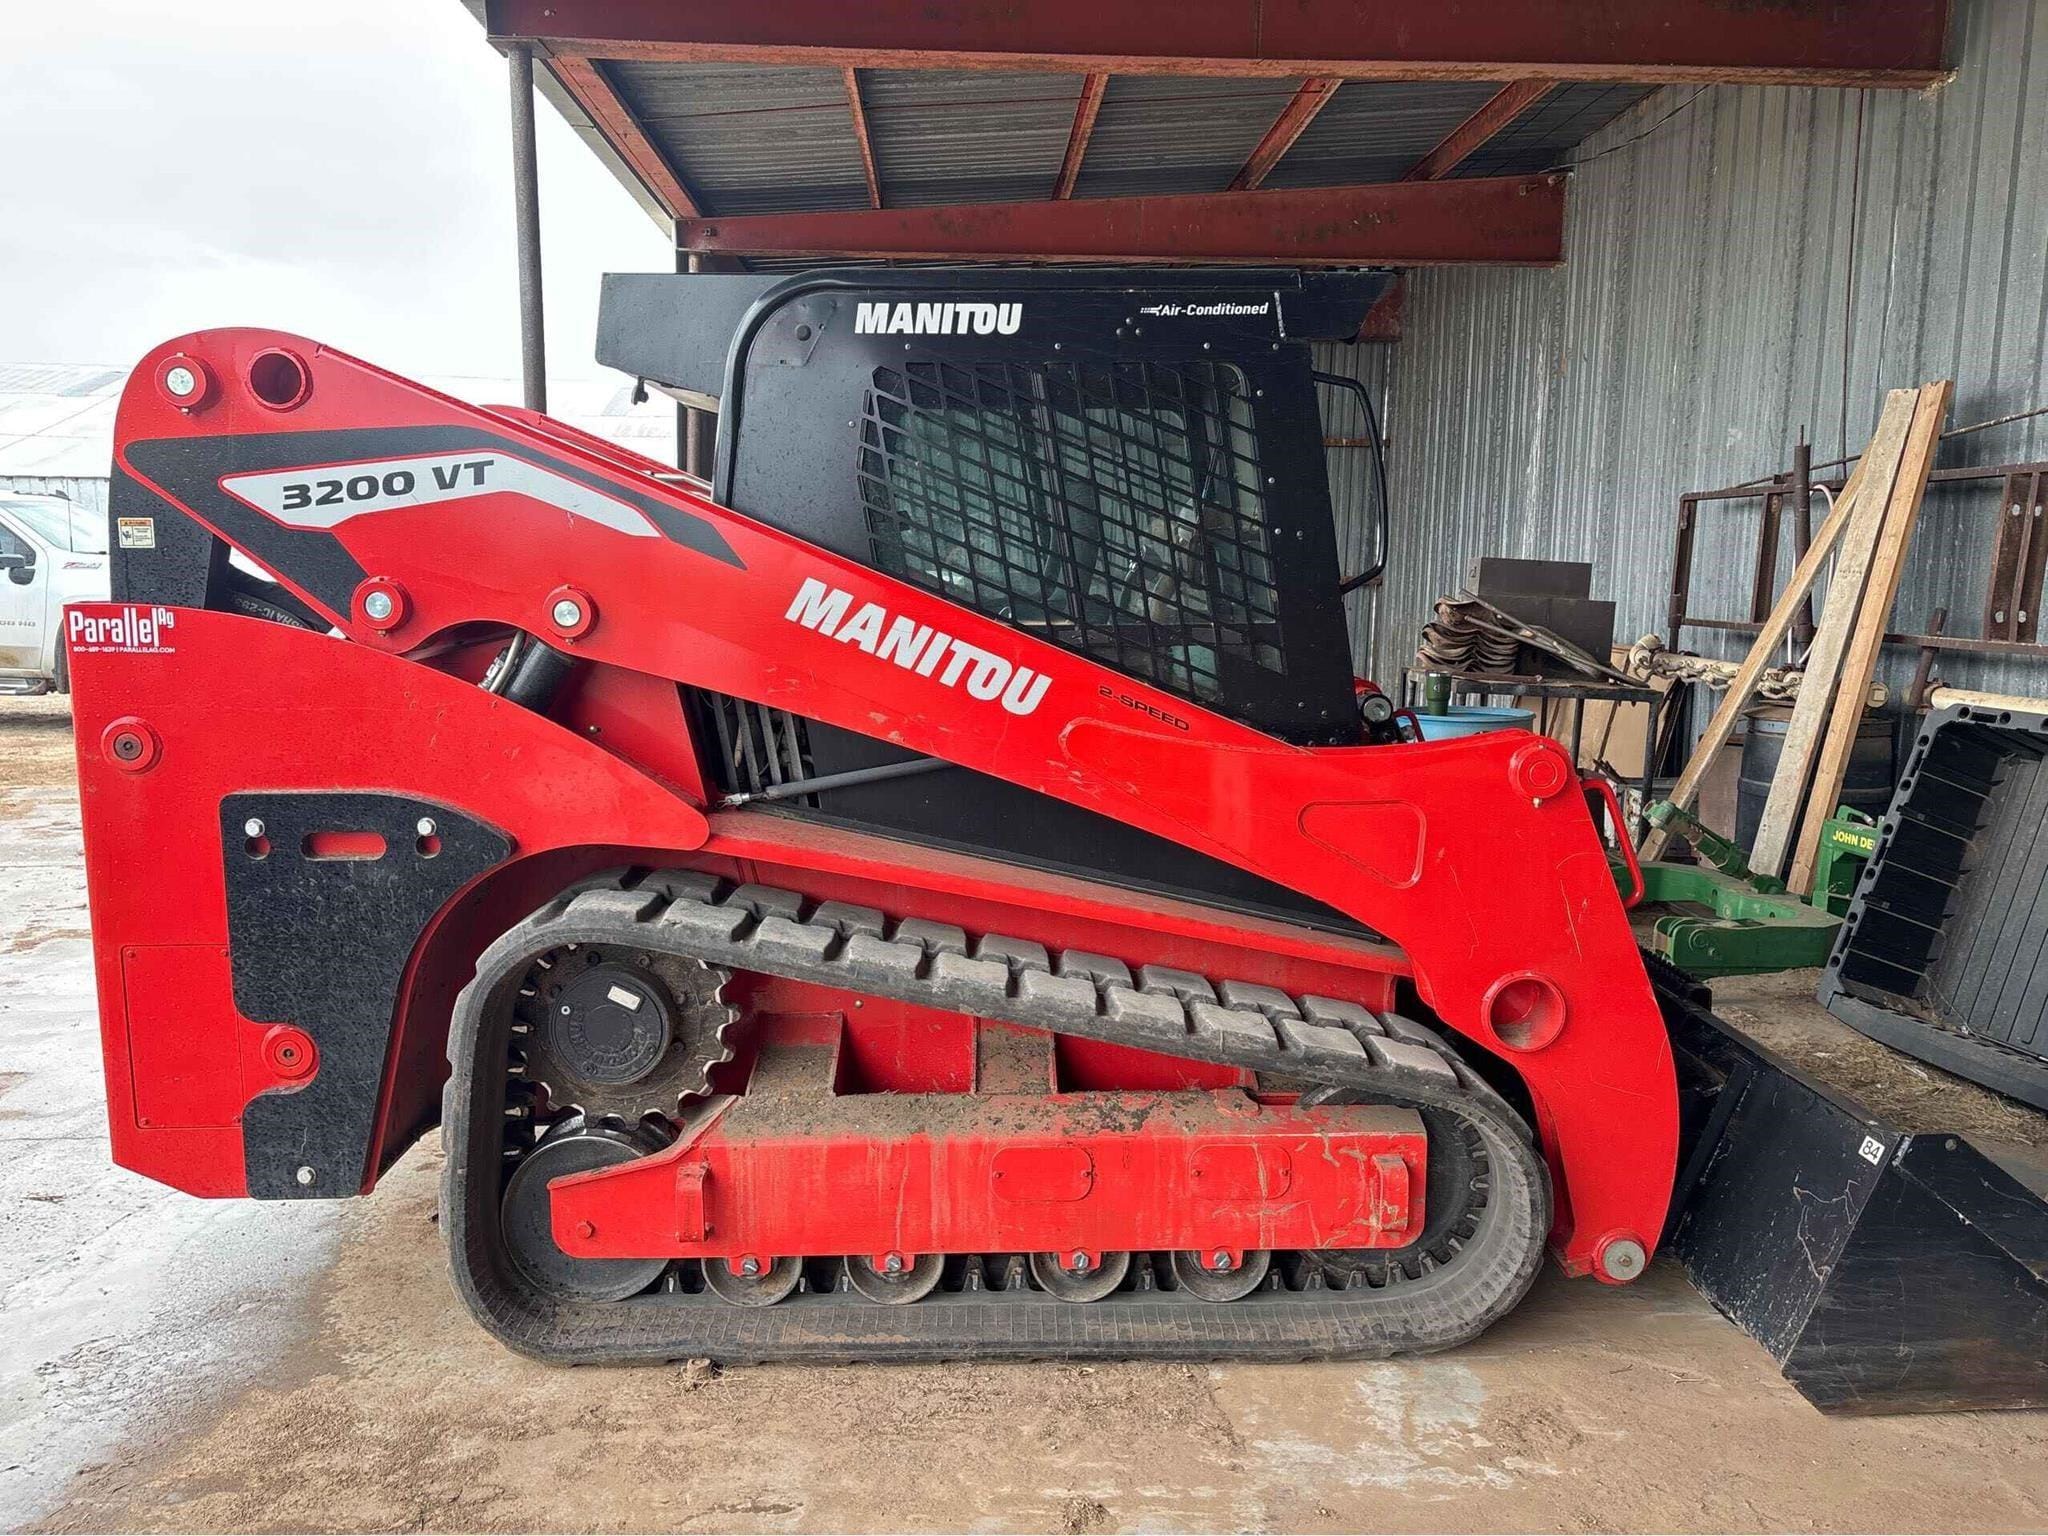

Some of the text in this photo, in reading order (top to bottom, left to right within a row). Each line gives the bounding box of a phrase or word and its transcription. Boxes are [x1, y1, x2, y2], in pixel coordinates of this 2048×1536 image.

[854, 303, 1023, 335] MANITOU
[1160, 302, 1269, 316] Air-Conditioned
[282, 460, 495, 510] 3200 VT
[784, 577, 1053, 716] MANITOU
[1099, 685, 1190, 731] 2-SPEED
[1832, 830, 1859, 847] JOHN
[1862, 1140, 1881, 1160] 84
